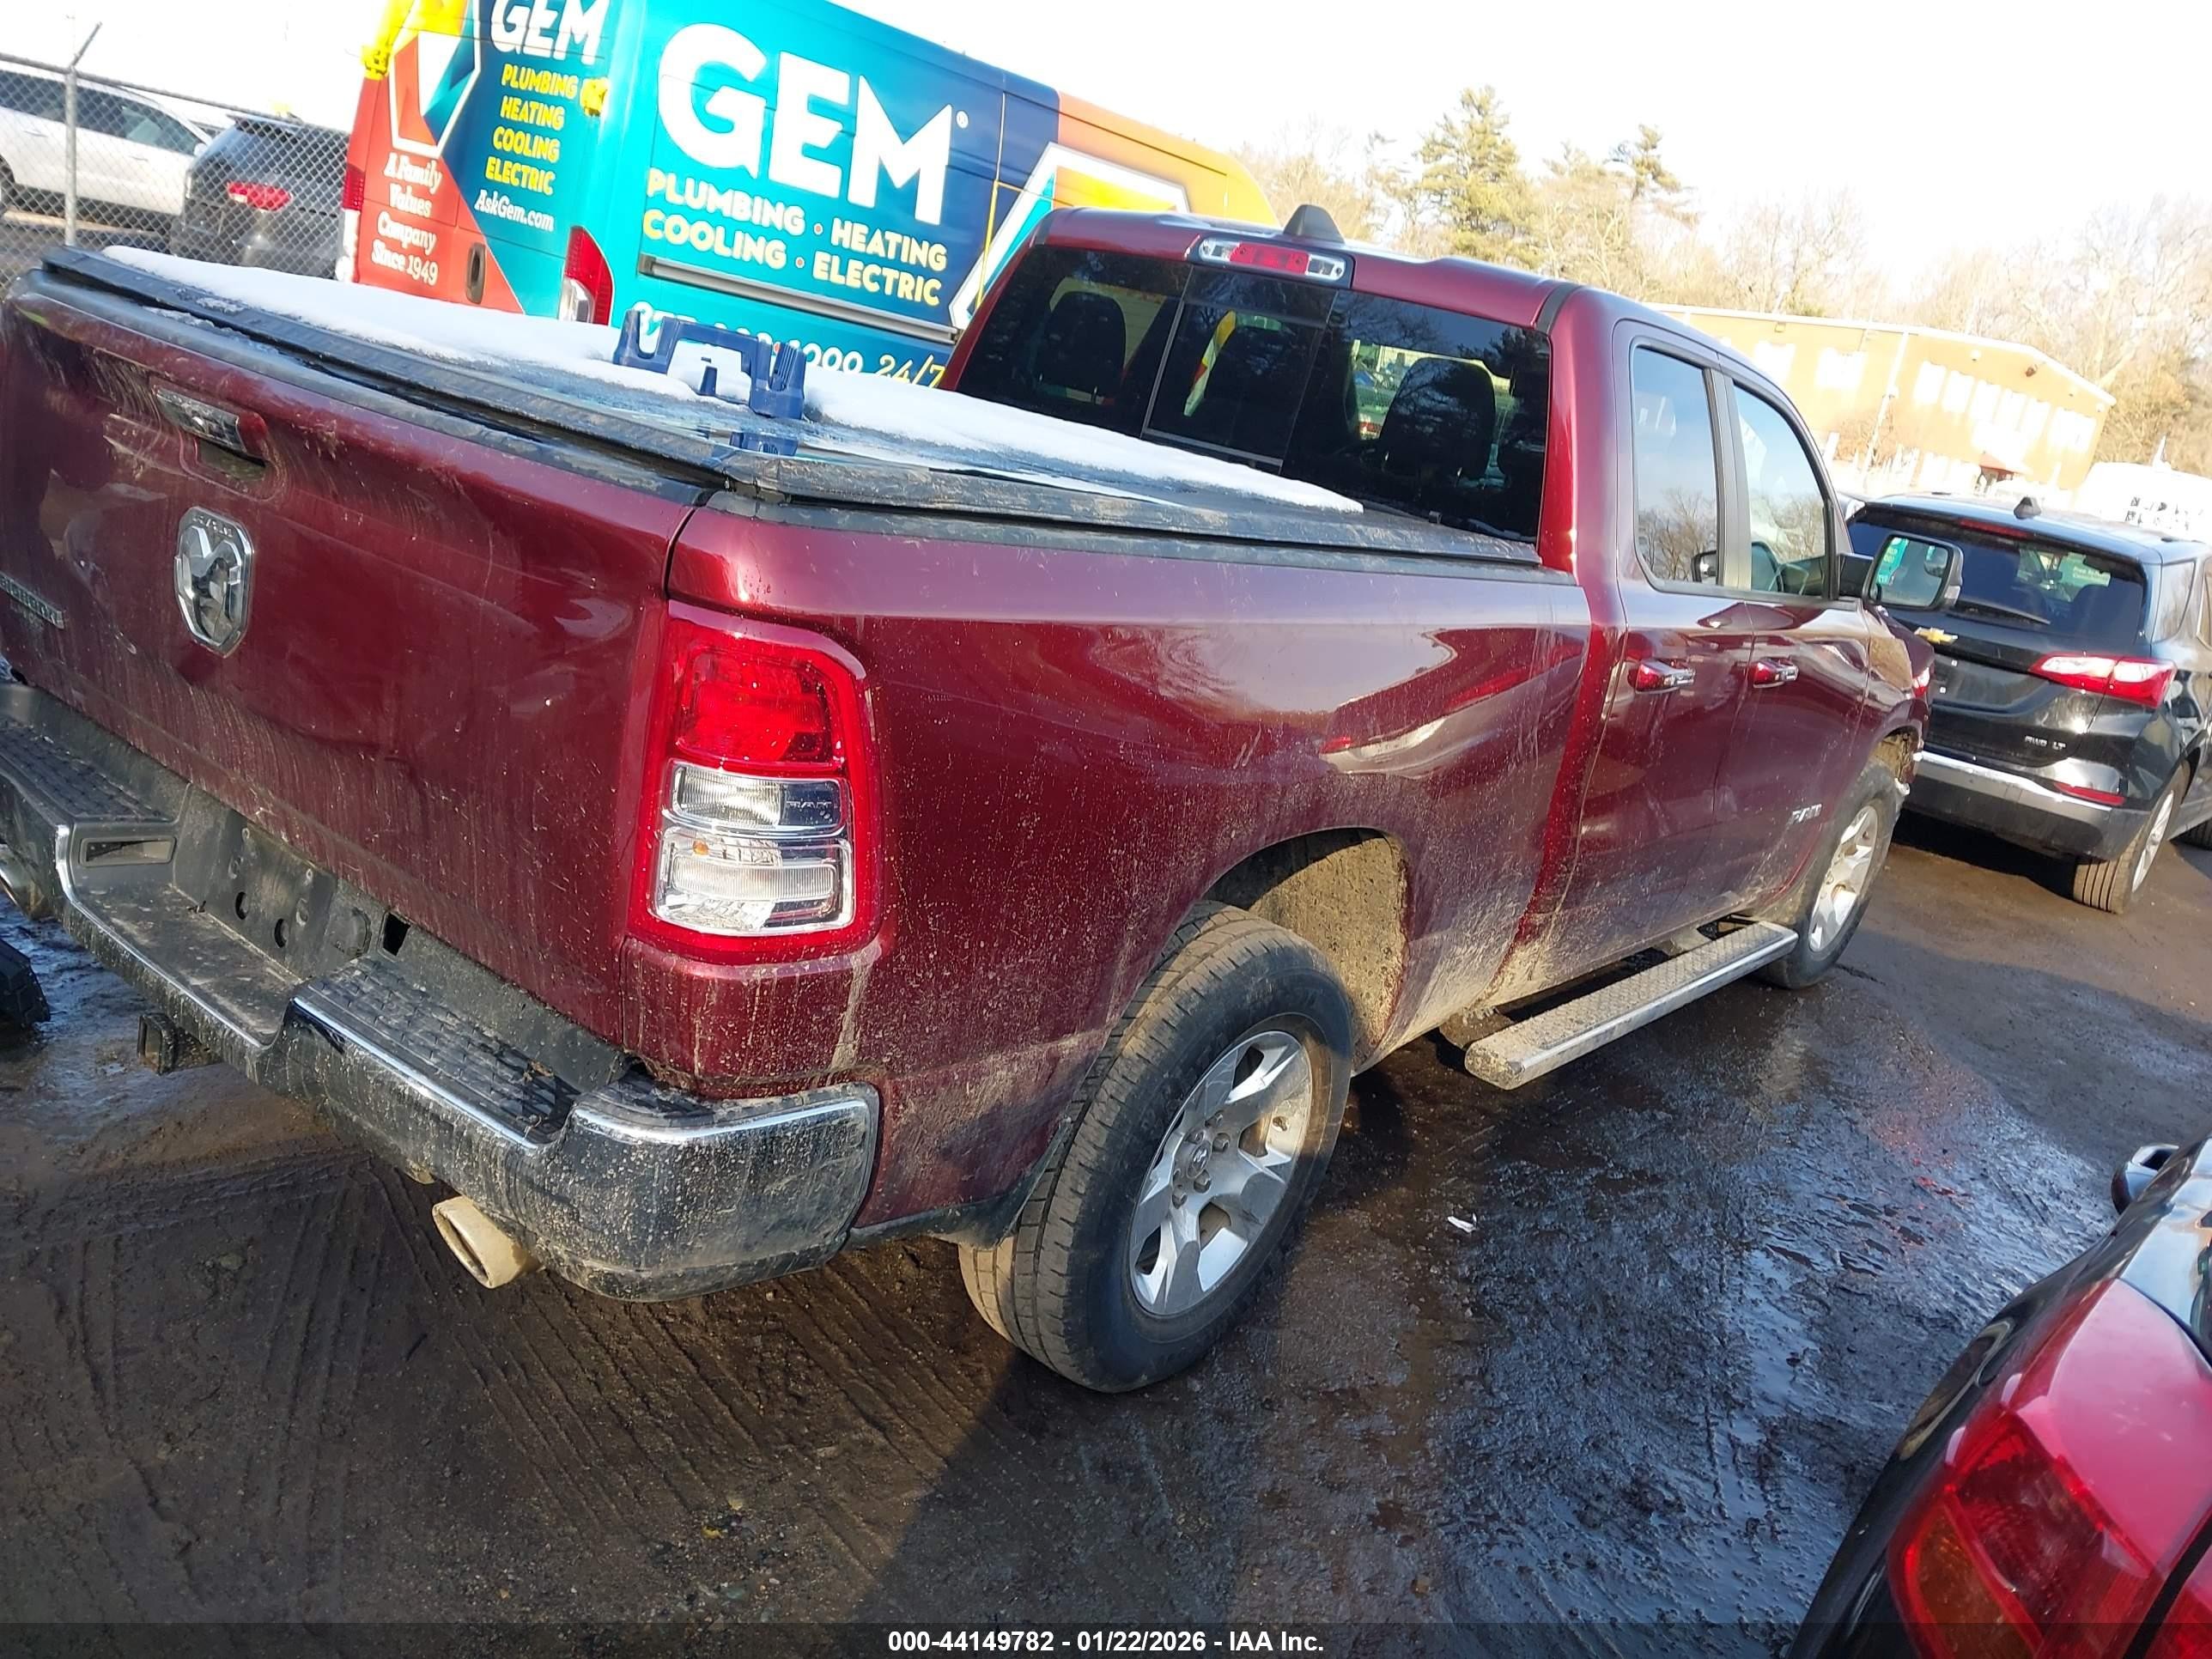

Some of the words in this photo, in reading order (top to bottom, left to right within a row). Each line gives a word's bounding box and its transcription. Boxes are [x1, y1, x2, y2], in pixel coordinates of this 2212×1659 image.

[490, 0, 611, 65] GEM
[501, 64, 580, 100] PLUMBING
[500, 95, 566, 131] HEATING
[657, 22, 953, 226] GEM
[493, 126, 561, 163] COOLING
[383, 152, 398, 179] A
[396, 155, 443, 195] Family
[485, 156, 556, 196] ELECTRIC
[389, 183, 433, 218] Values
[474, 189, 555, 232] AskGem.com
[646, 167, 805, 236] PLUMBING
[830, 217, 947, 272] HEATING
[377, 210, 438, 256] Company
[371, 239, 407, 272] Since
[405, 254, 440, 287] 1949
[642, 209, 787, 270] COOLING
[812, 252, 943, 307] ELECTRIC
[874, 354, 946, 389] 24/7
[2052, 741, 2066, 750] LT
